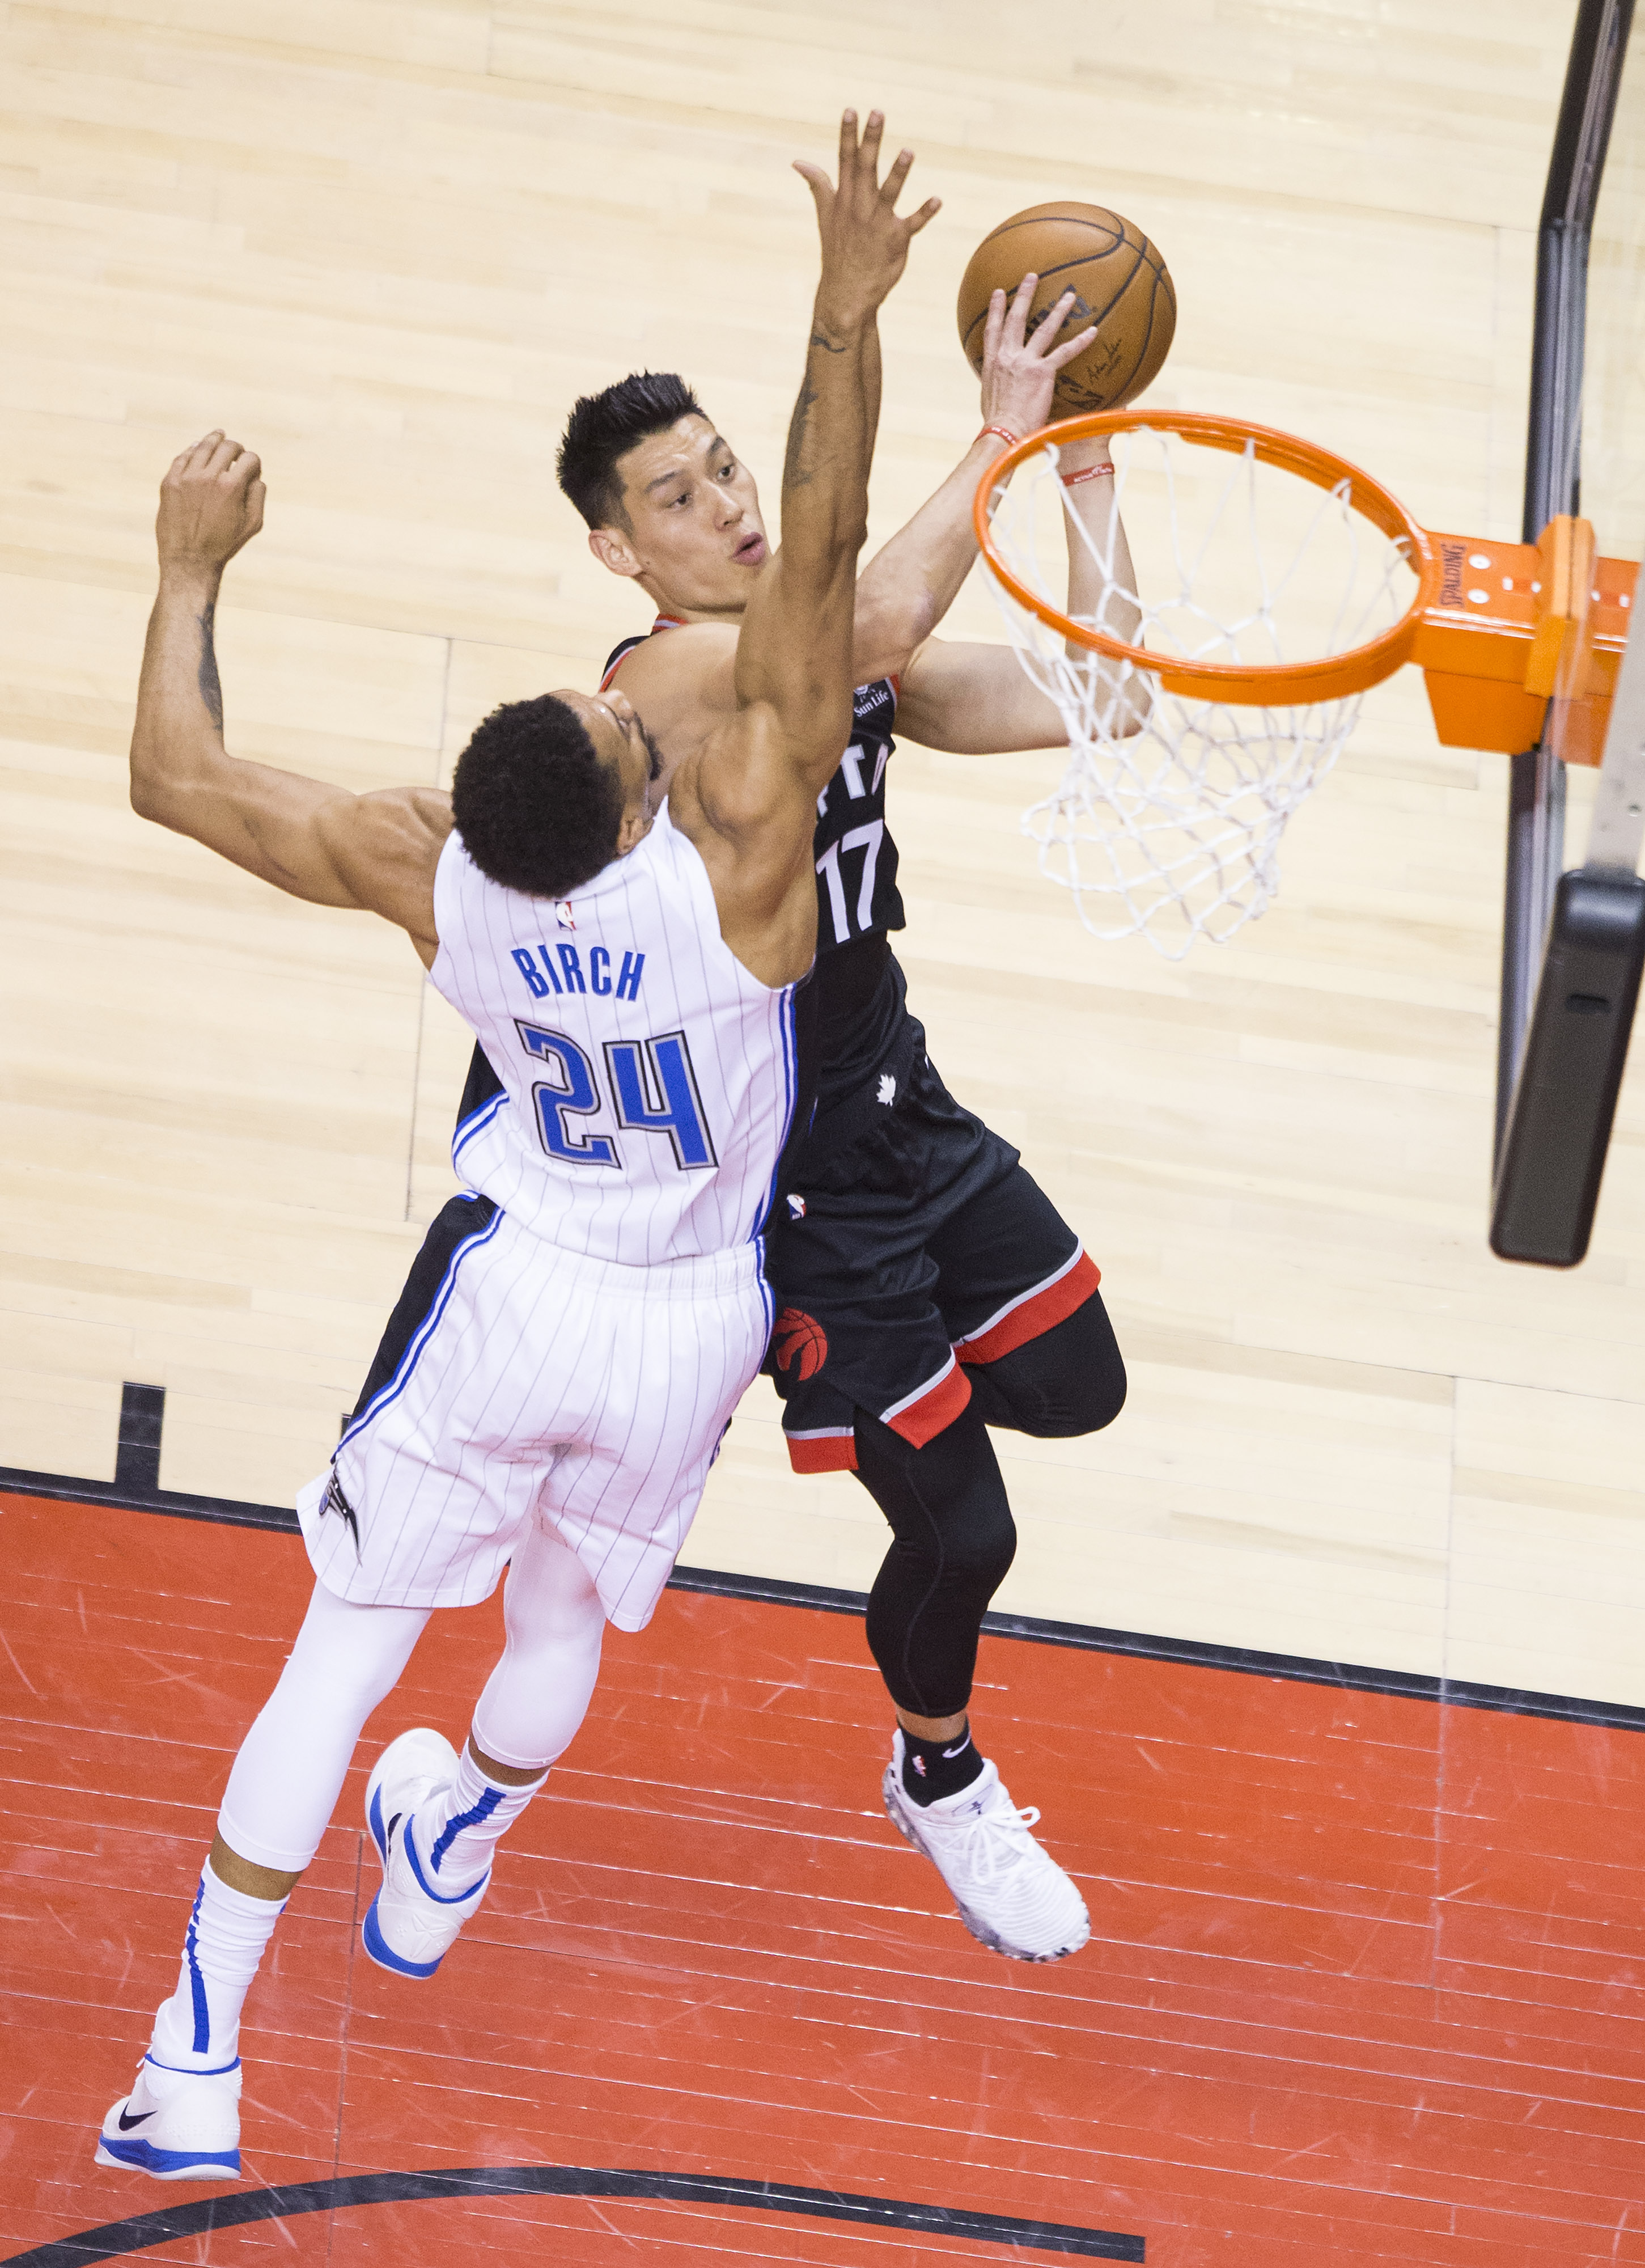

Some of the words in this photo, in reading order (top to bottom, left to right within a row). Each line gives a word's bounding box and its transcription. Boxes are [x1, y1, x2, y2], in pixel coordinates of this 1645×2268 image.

[1440, 543, 1466, 608] SPALDING
[853, 701, 874, 718] Sun
[871, 690, 889, 707] Life
[815, 818, 884, 944] 17
[510, 943, 646, 1002] BIRCH
[513, 1018, 720, 1171] 24
